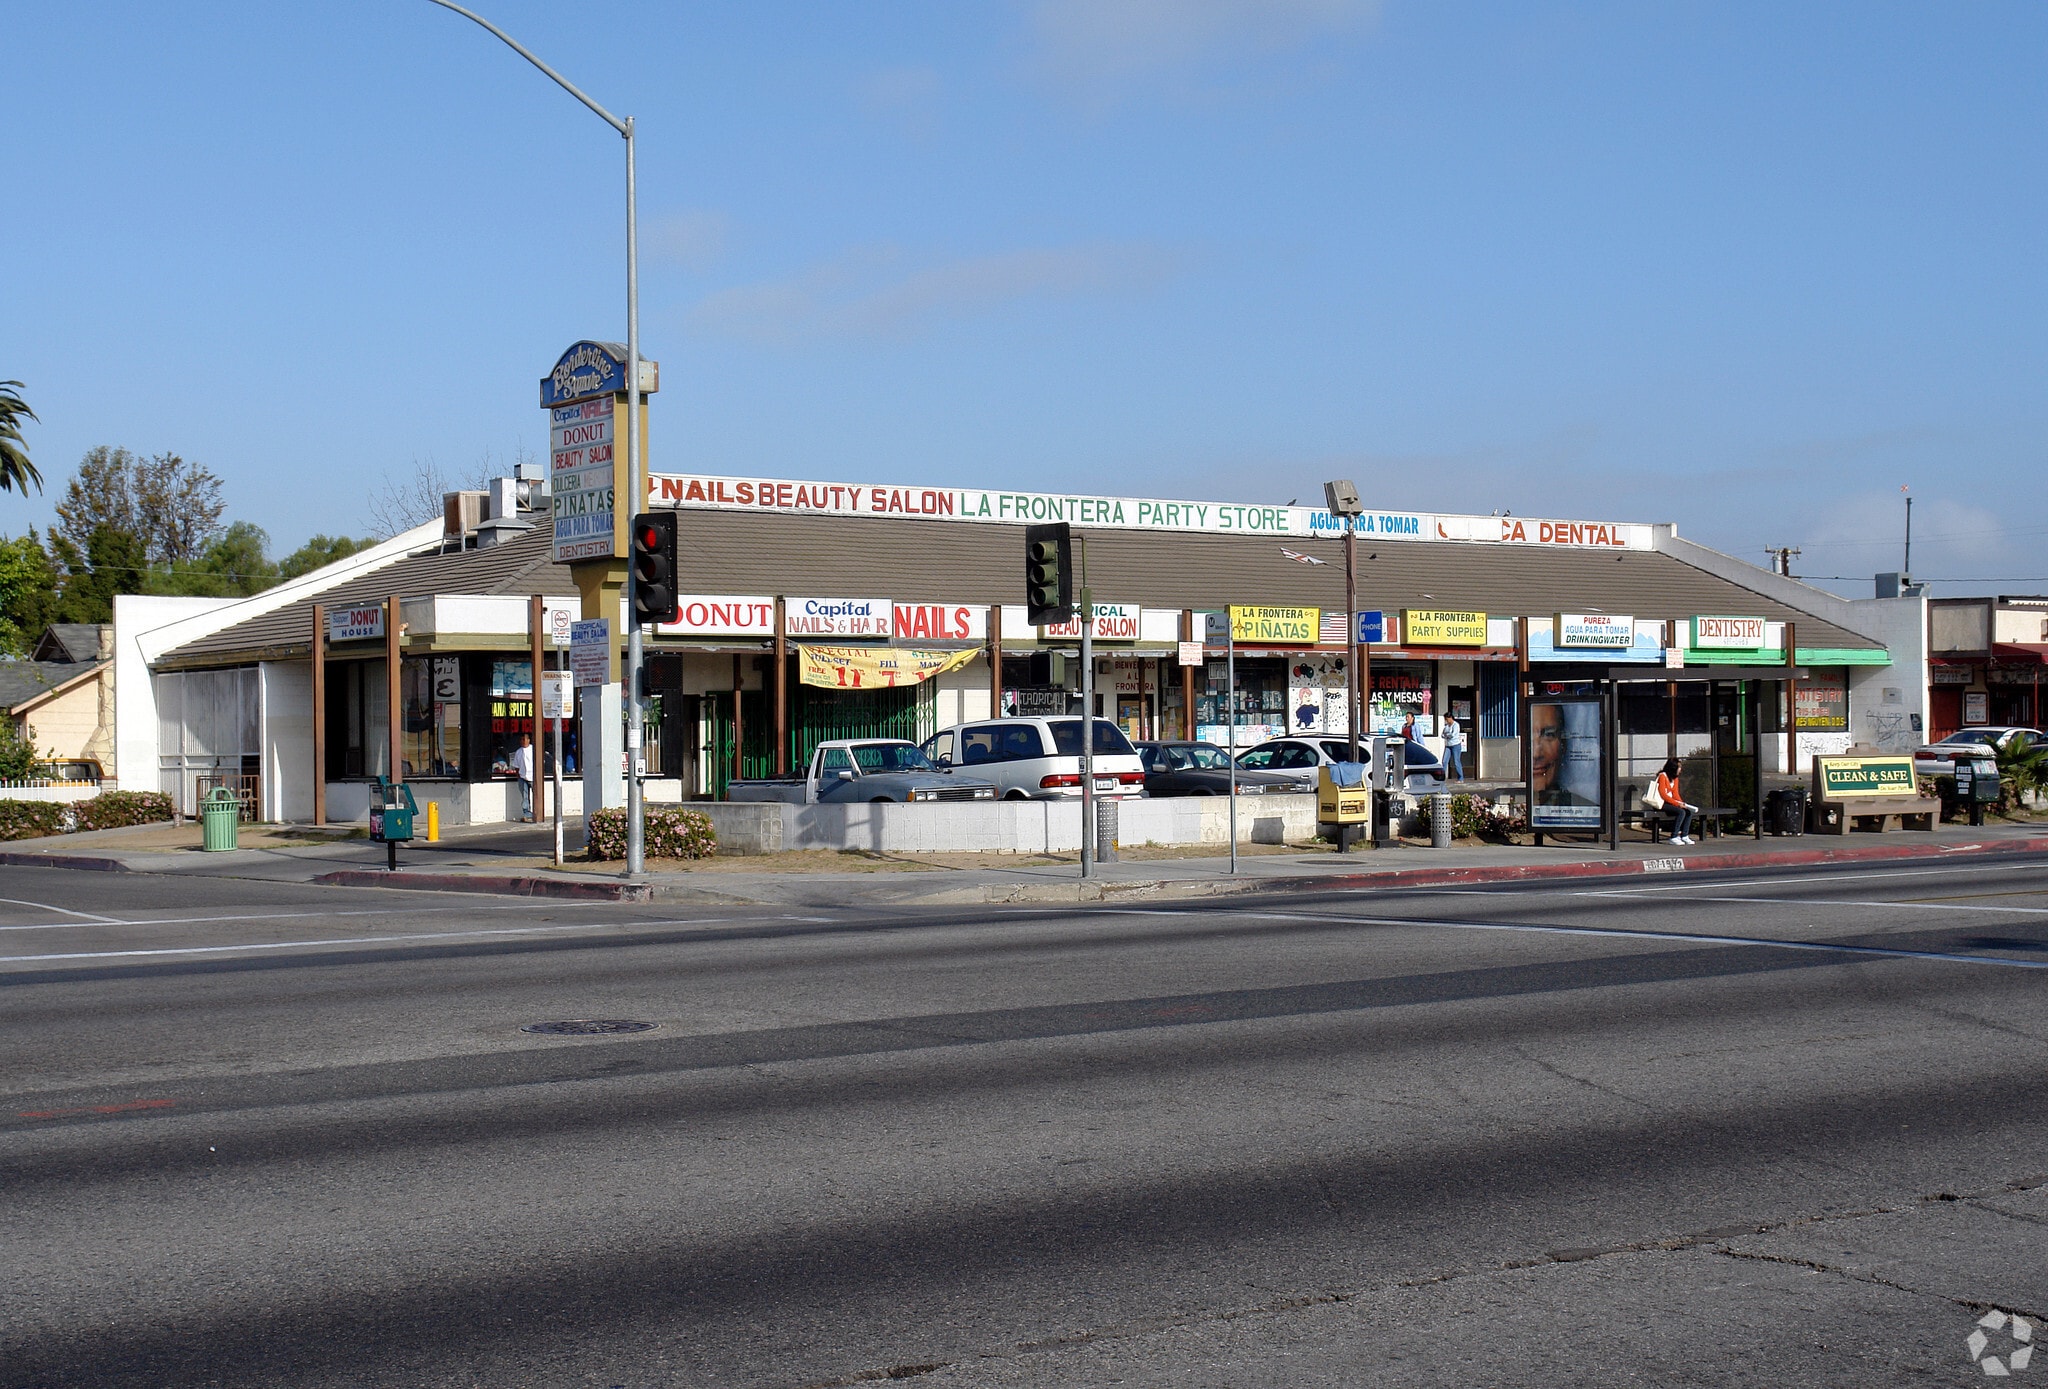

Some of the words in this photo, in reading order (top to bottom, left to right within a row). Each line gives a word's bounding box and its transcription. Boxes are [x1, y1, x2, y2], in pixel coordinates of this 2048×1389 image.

[553, 345, 614, 398] Borderline
[563, 371, 604, 399] Square
[580, 398, 613, 420] NAILS
[563, 422, 605, 446] DONUT
[556, 450, 584, 469] BEAUTY
[589, 444, 612, 464] SALON
[554, 474, 581, 492] DULCERIA
[662, 477, 755, 504] NAILS
[758, 483, 861, 511] BEAUTY
[872, 488, 954, 515] SALON
[961, 492, 992, 517] LA
[1000, 495, 1125, 524] FRONTERA
[1138, 502, 1208, 527] PARTY
[1219, 506, 1289, 531] STORE
[556, 519, 571, 538] AGUA
[573, 516, 590, 536] PARA
[591, 513, 613, 533] TOMAR
[1309, 512, 1340, 530] AGUA
[1379, 516, 1419, 534] TOMAR
[1540, 522, 1625, 546] DENTAL
[560, 540, 611, 558] DENTISTRY
[805, 600, 872, 617] Capital
[1242, 607, 1255, 618] LA
[1258, 608, 1303, 619] FRONTERA
[350, 609, 379, 626] DONUT
[837, 619, 846, 633] &
[895, 606, 971, 639] NAILS
[1419, 612, 1431, 621] LA
[1434, 613, 1476, 623] FRONTERA
[1584, 616, 1611, 625] PUREZA
[341, 627, 374, 637] HOUSE
[571, 630, 590, 640] BEAUTY
[591, 628, 607, 638] SALON
[1098, 617, 1137, 637] SALON
[1244, 619, 1309, 639] PIÑATAS
[1361, 623, 1382, 631] PHONE
[1412, 626, 1441, 637] PARTY
[1446, 626, 1484, 638] SUPPLIES
[1565, 625, 1583, 634] AGUA
[1585, 625, 1603, 634] PARA
[1605, 626, 1629, 635] TOMAR
[1699, 619, 1763, 638] DENTISTRY
[808, 666, 827, 674] FREE
[880, 660, 899, 668] FILL
[1380, 676, 1419, 689] RENTAN
[1393, 691, 1423, 703] MESAS
[509, 702, 527, 717] SPLIT
[1829, 771, 1867, 782] CLEAN
[1869, 771, 1879, 781] &
[1880, 770, 1908, 781] SAFE
